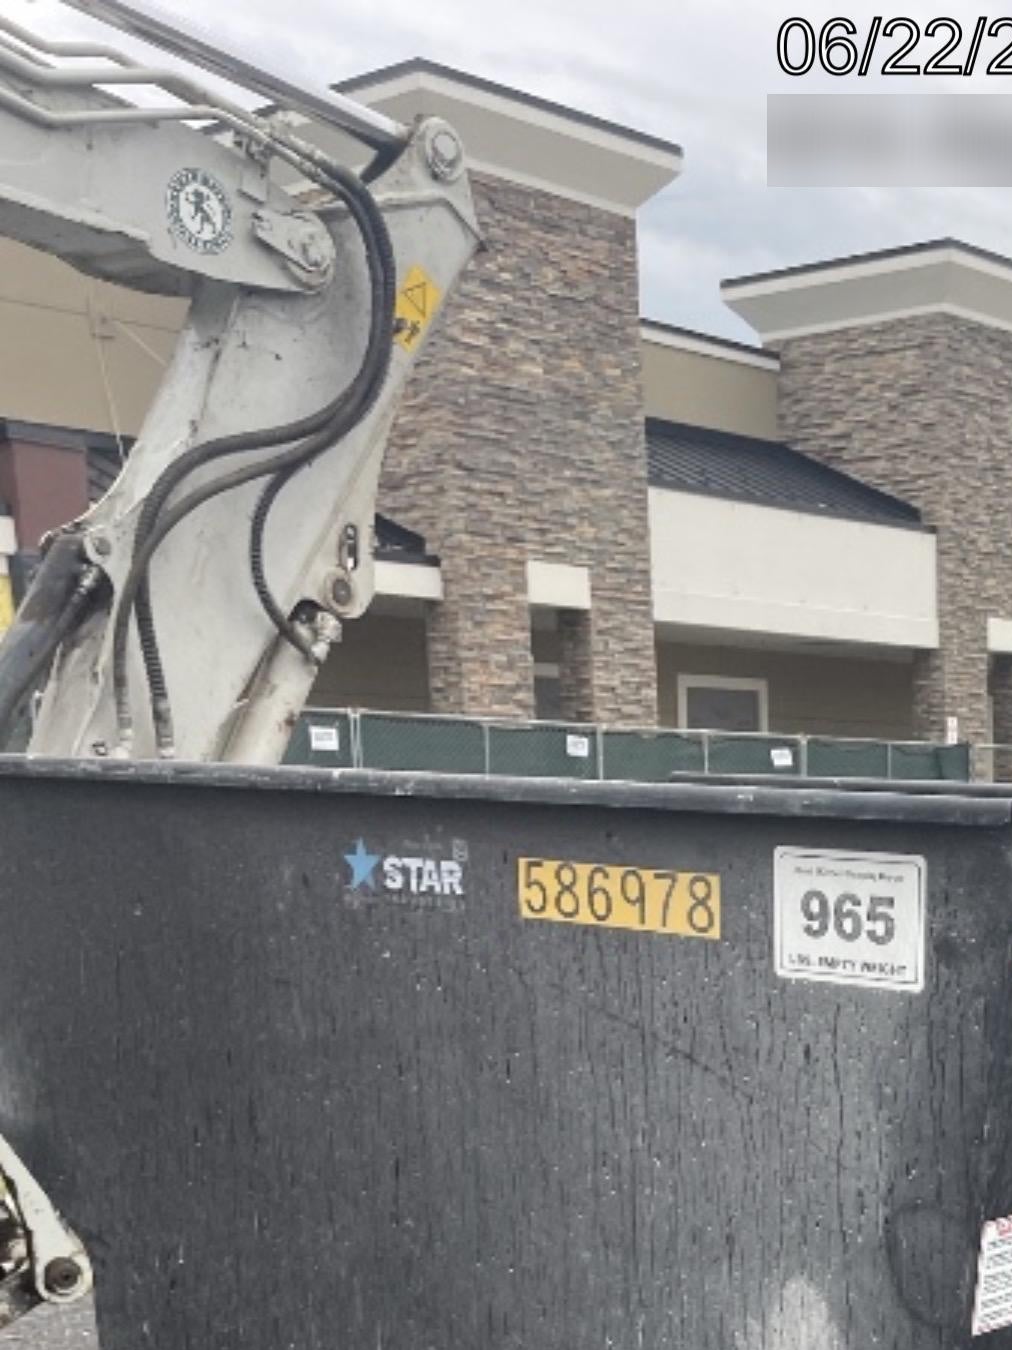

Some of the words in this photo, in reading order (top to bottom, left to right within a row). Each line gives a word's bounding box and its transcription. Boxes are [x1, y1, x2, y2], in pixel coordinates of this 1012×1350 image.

[382, 855, 465, 896] STAR
[524, 860, 715, 934] 586978
[800, 889, 896, 946] 965
